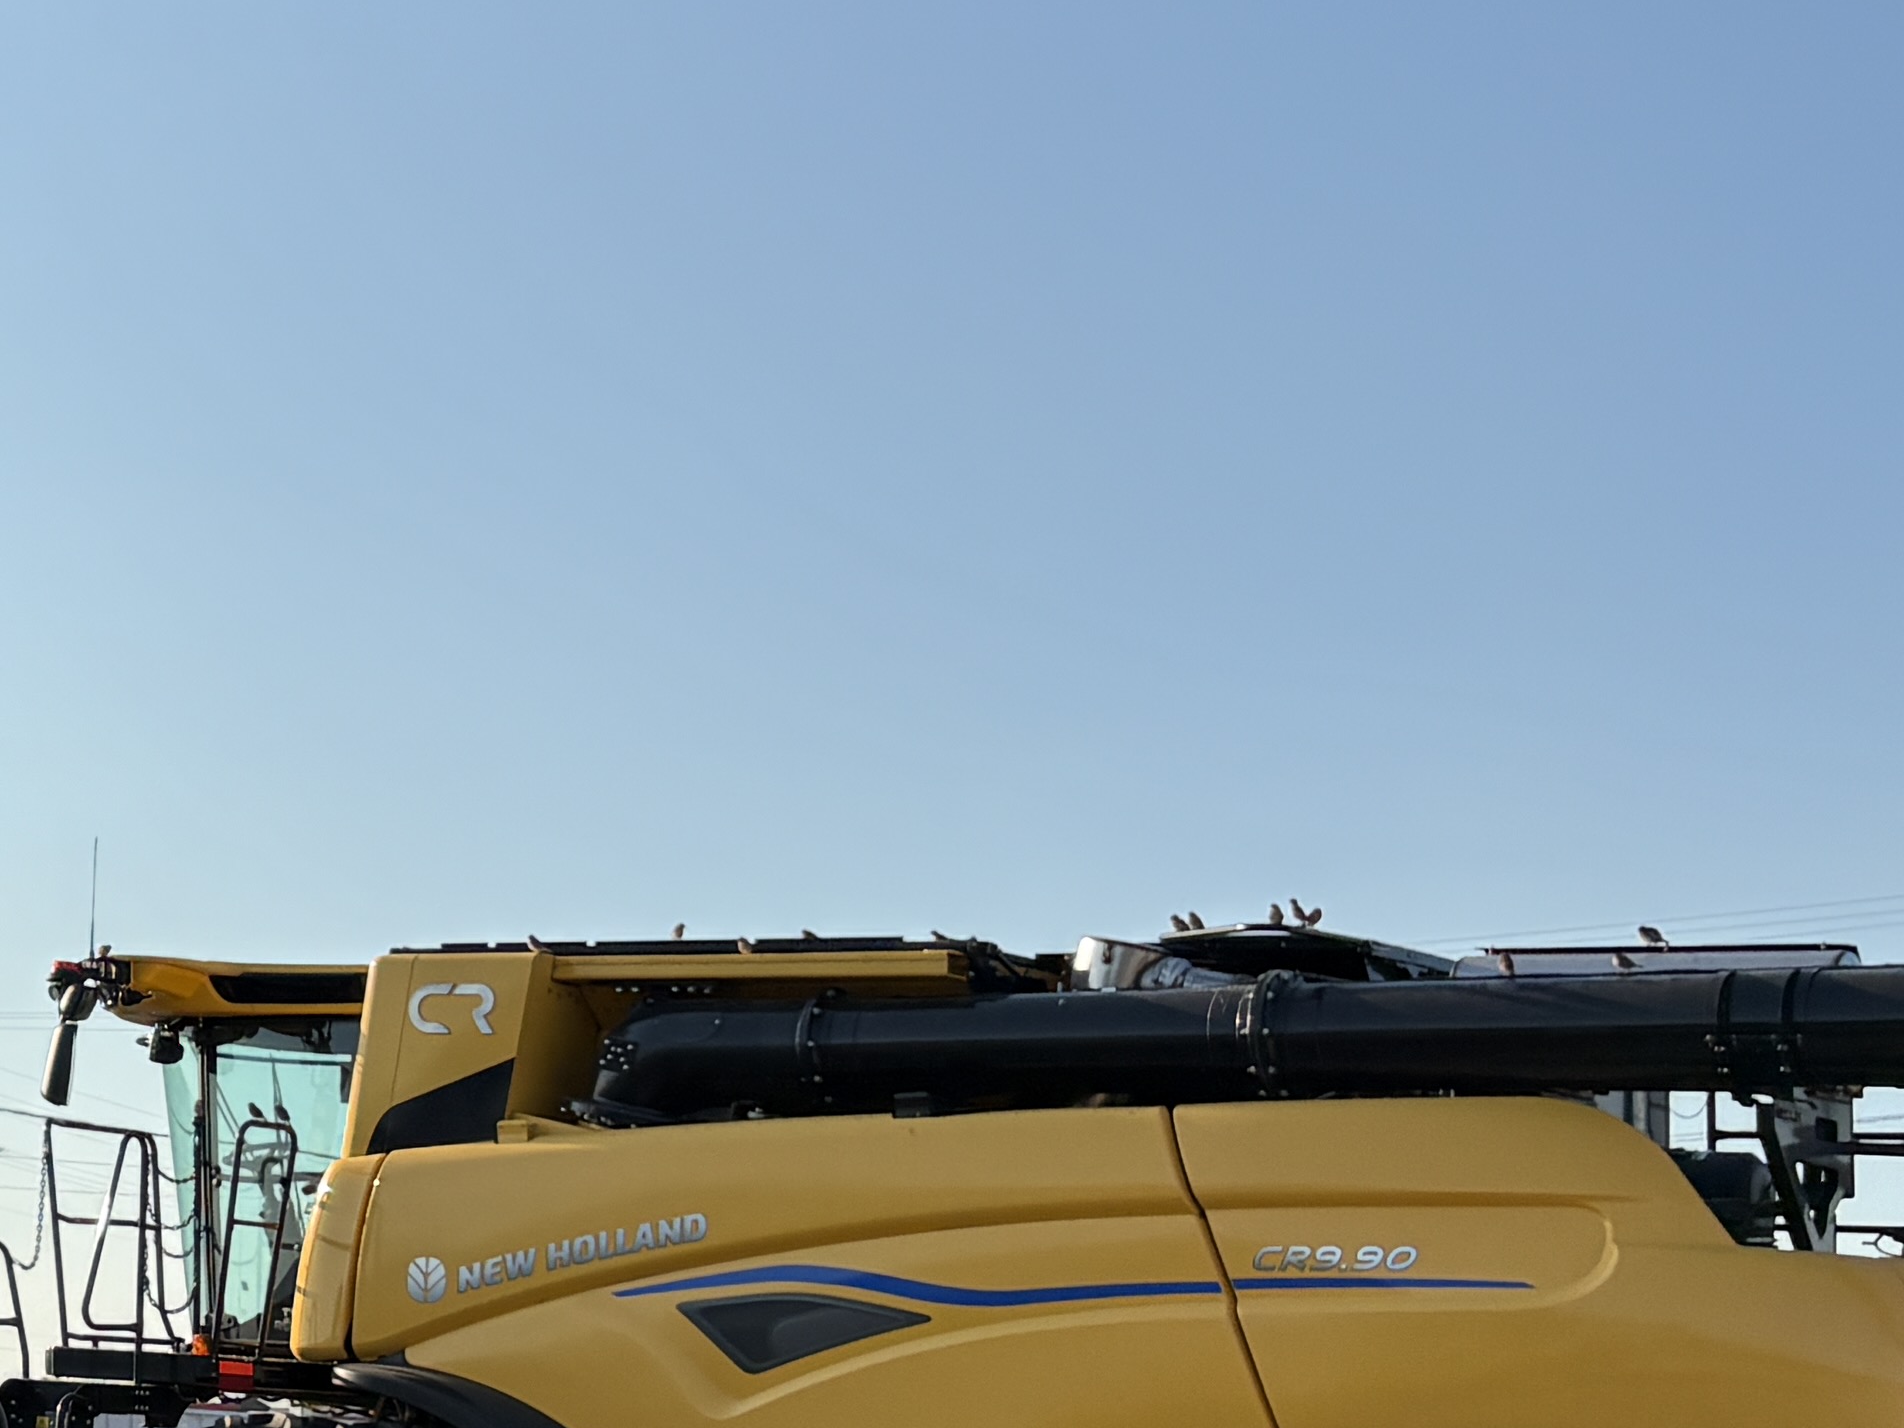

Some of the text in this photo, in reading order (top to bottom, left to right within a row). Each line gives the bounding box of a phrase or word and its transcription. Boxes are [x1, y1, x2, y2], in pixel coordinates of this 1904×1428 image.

[408, 983, 495, 1035] CR
[457, 1213, 708, 1294] NEW HOLLAND
[1253, 1245, 1418, 1272] CR9.90
